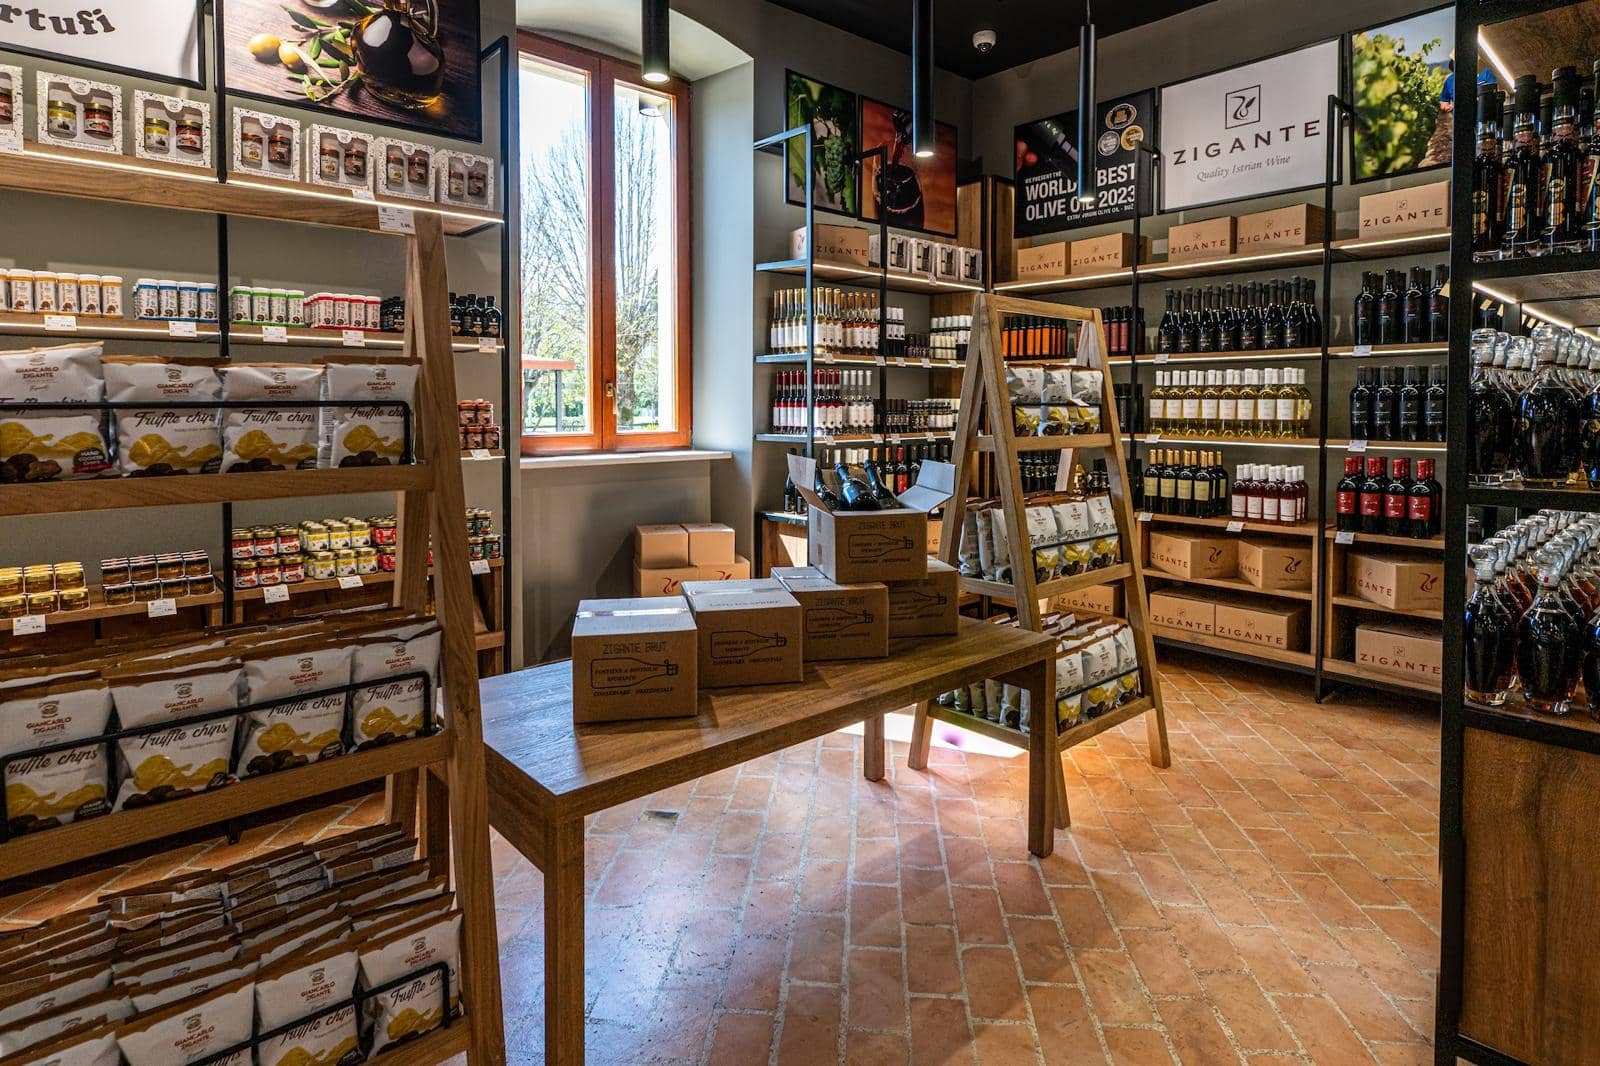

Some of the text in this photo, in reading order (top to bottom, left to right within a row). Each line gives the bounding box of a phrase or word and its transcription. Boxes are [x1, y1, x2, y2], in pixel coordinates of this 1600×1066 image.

[1173, 119, 1321, 166] ZIGANTE
[1097, 162, 1136, 187] BEST
[1197, 155, 1291, 182] Quality Istrian Wine
[1025, 199, 1066, 221] OLIVE
[1098, 184, 1136, 209] 2023
[1363, 207, 1444, 227] ZIGANTE
[1239, 227, 1302, 245] ZIGANTE
[816, 245, 868, 257] ZIGANTE
[1171, 239, 1227, 254] ZIGANTE
[1020, 260, 1063, 273] ZIGANTE
[1073, 252, 1119, 266] ZIGANTE
[134, 411, 181, 427] Truffle
[242, 409, 282, 425] Truffle
[1151, 552, 1188, 569] ZIGANTE
[1060, 597, 1111, 612] ZIGANTE
[1153, 614, 1212, 632] ZIGANTE
[1219, 626, 1284, 645] ZIGANTE
[1360, 653, 1441, 674] ZIGANTE
[367, 683, 403, 702] Truffle
[26, 716, 72, 729] GIANCARLO
[7, 748, 98, 776] ruffle chips
[300, 981, 336, 998] GIANCARLO
[390, 979, 426, 1008] Truffle
